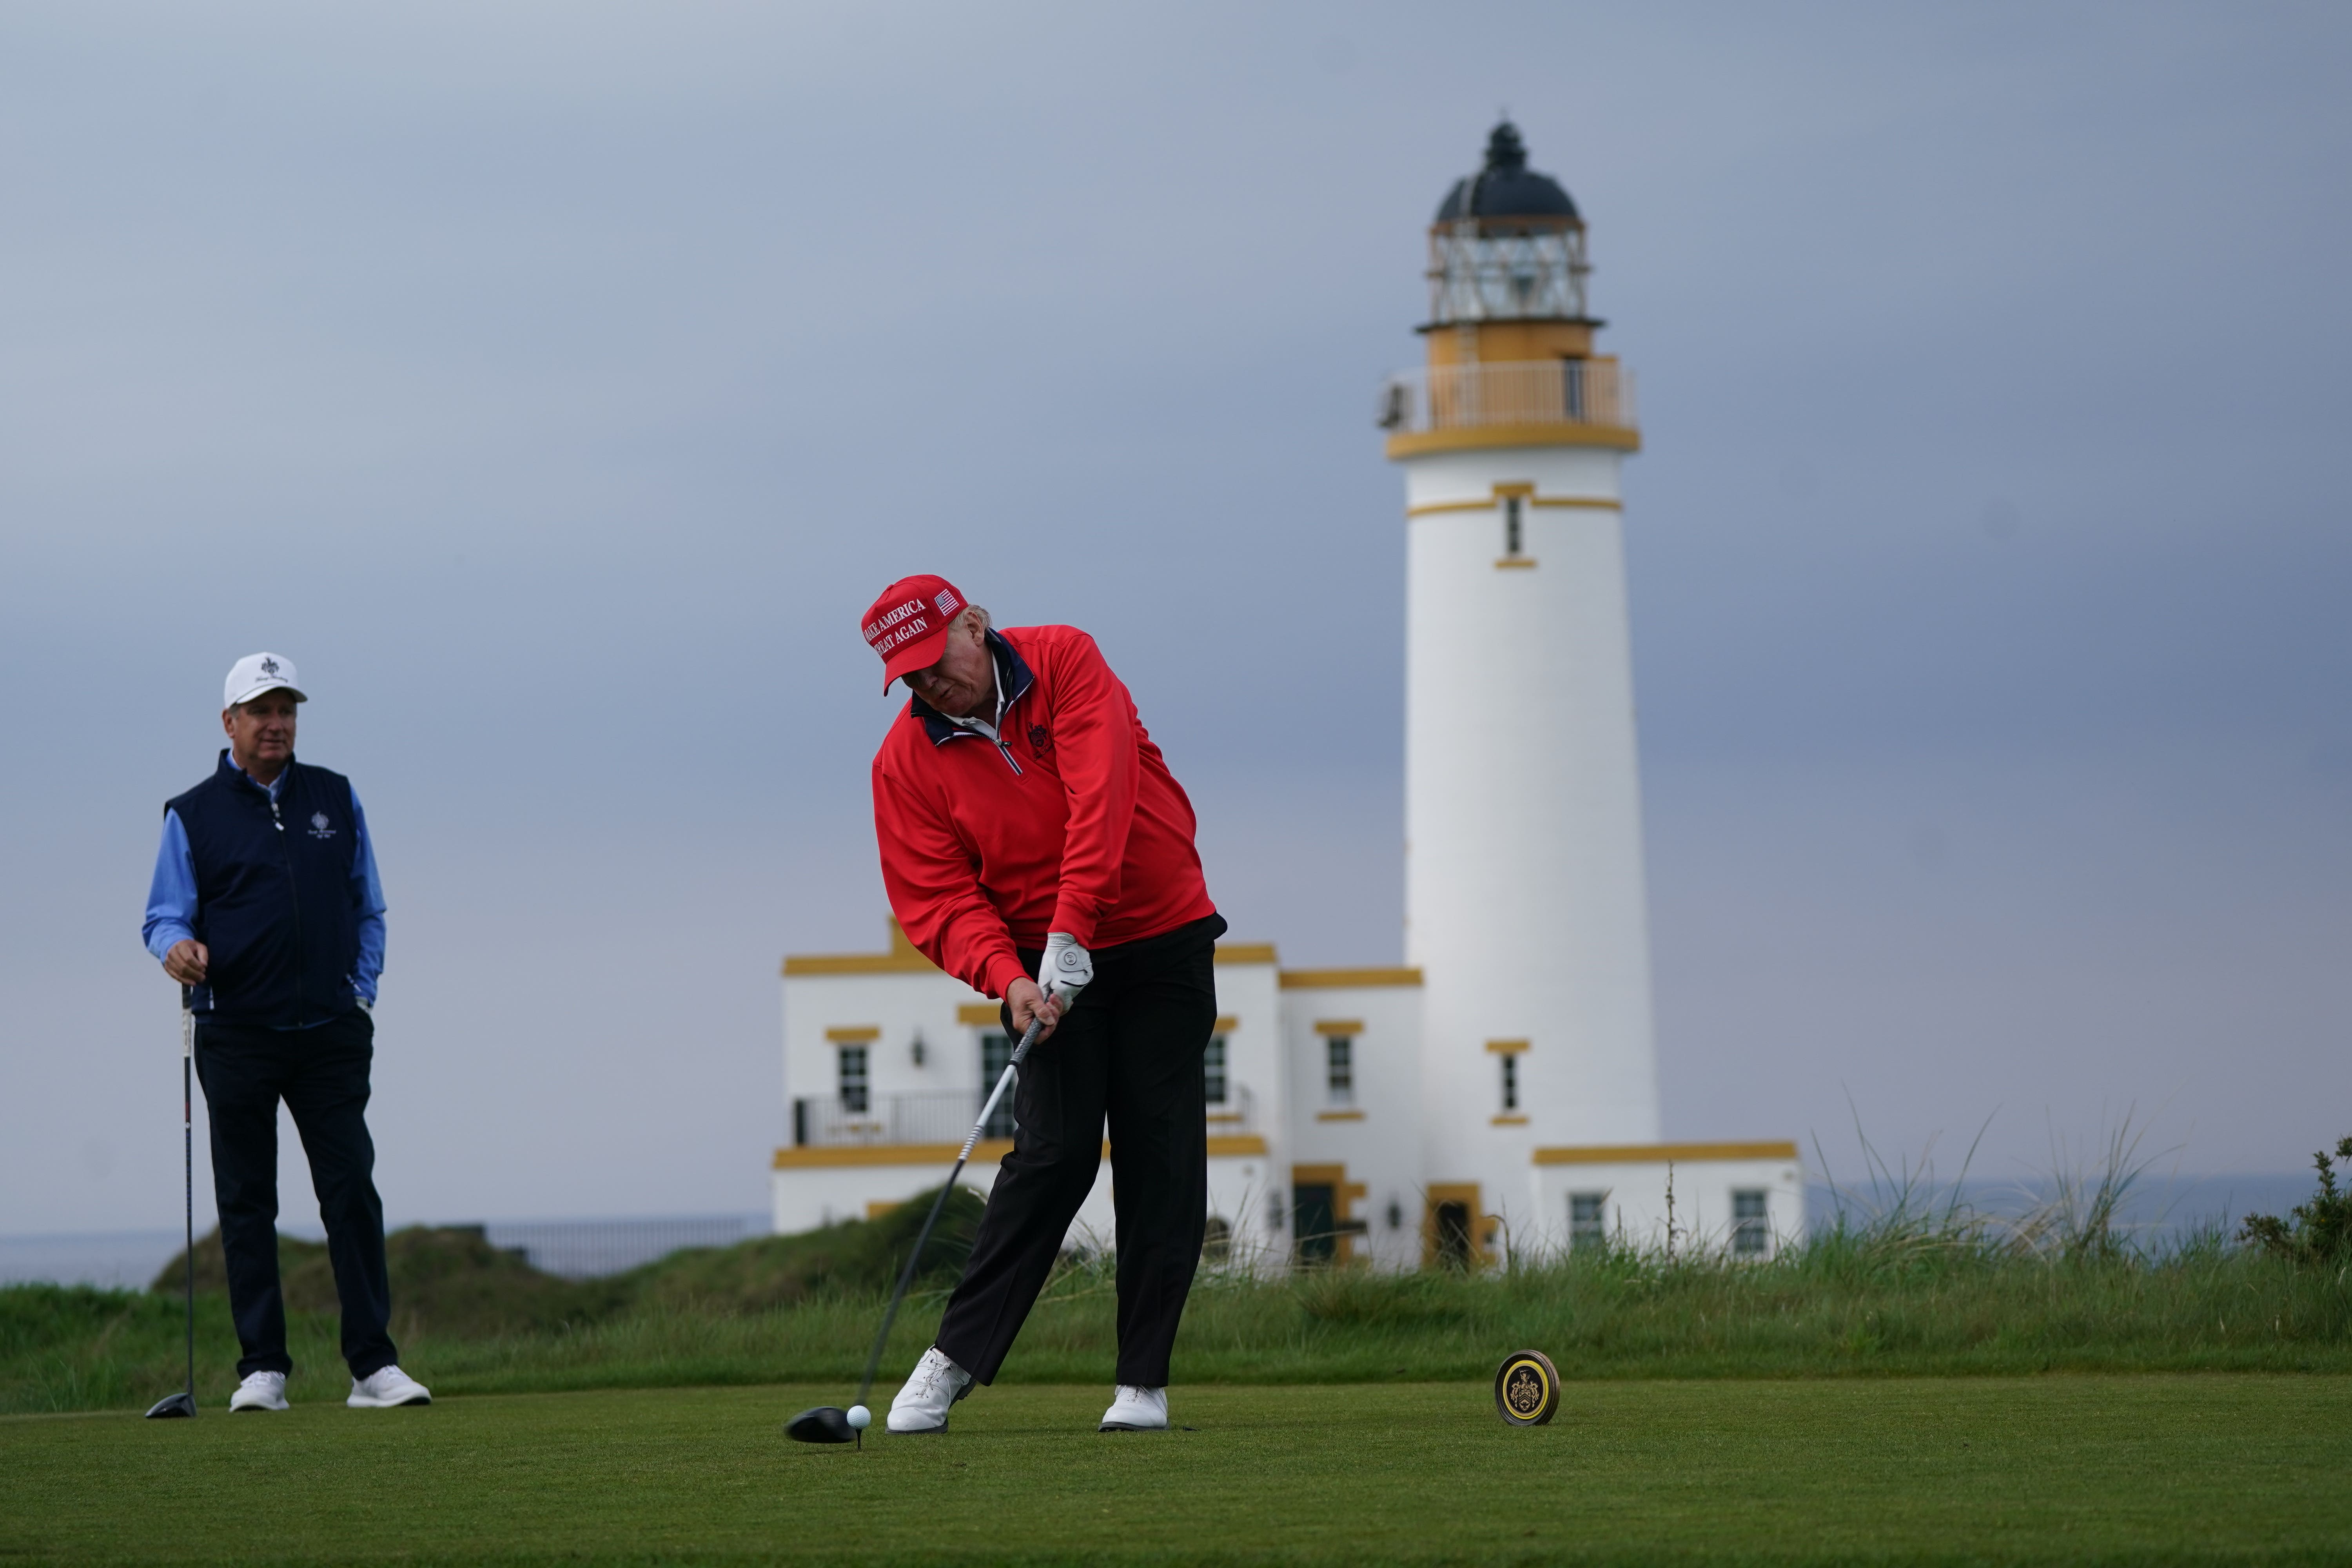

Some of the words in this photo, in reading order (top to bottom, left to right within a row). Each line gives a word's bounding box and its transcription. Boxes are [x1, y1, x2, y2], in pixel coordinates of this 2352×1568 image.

[878, 599, 926, 632] AMERICA
[874, 634, 895, 657] REAT
[895, 617, 928, 644] AGAIN
